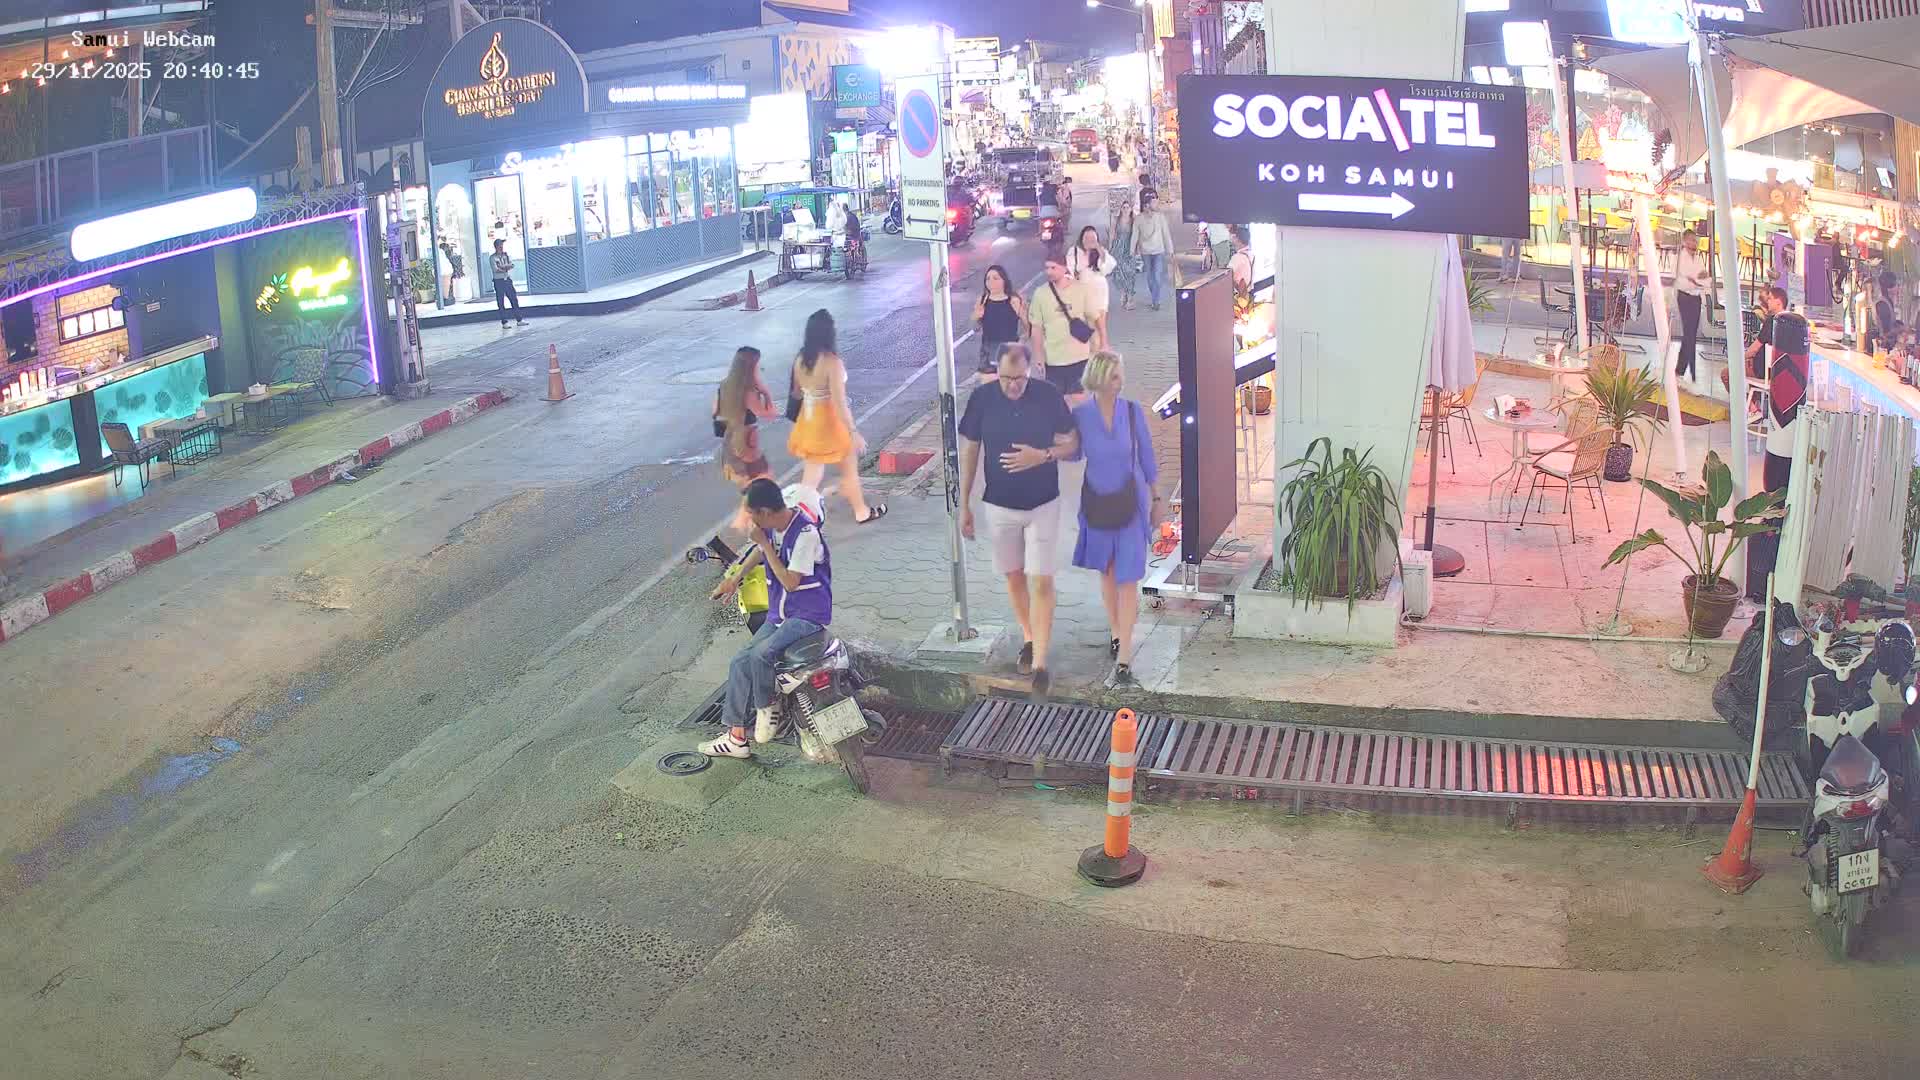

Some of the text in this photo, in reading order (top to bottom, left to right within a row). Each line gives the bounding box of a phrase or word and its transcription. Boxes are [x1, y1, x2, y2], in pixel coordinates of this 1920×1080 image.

[839, 90, 879, 102] EXCHANGE
[1258, 163, 1454, 190] KOH SAMUI
[907, 198, 940, 208] NO PARKING
